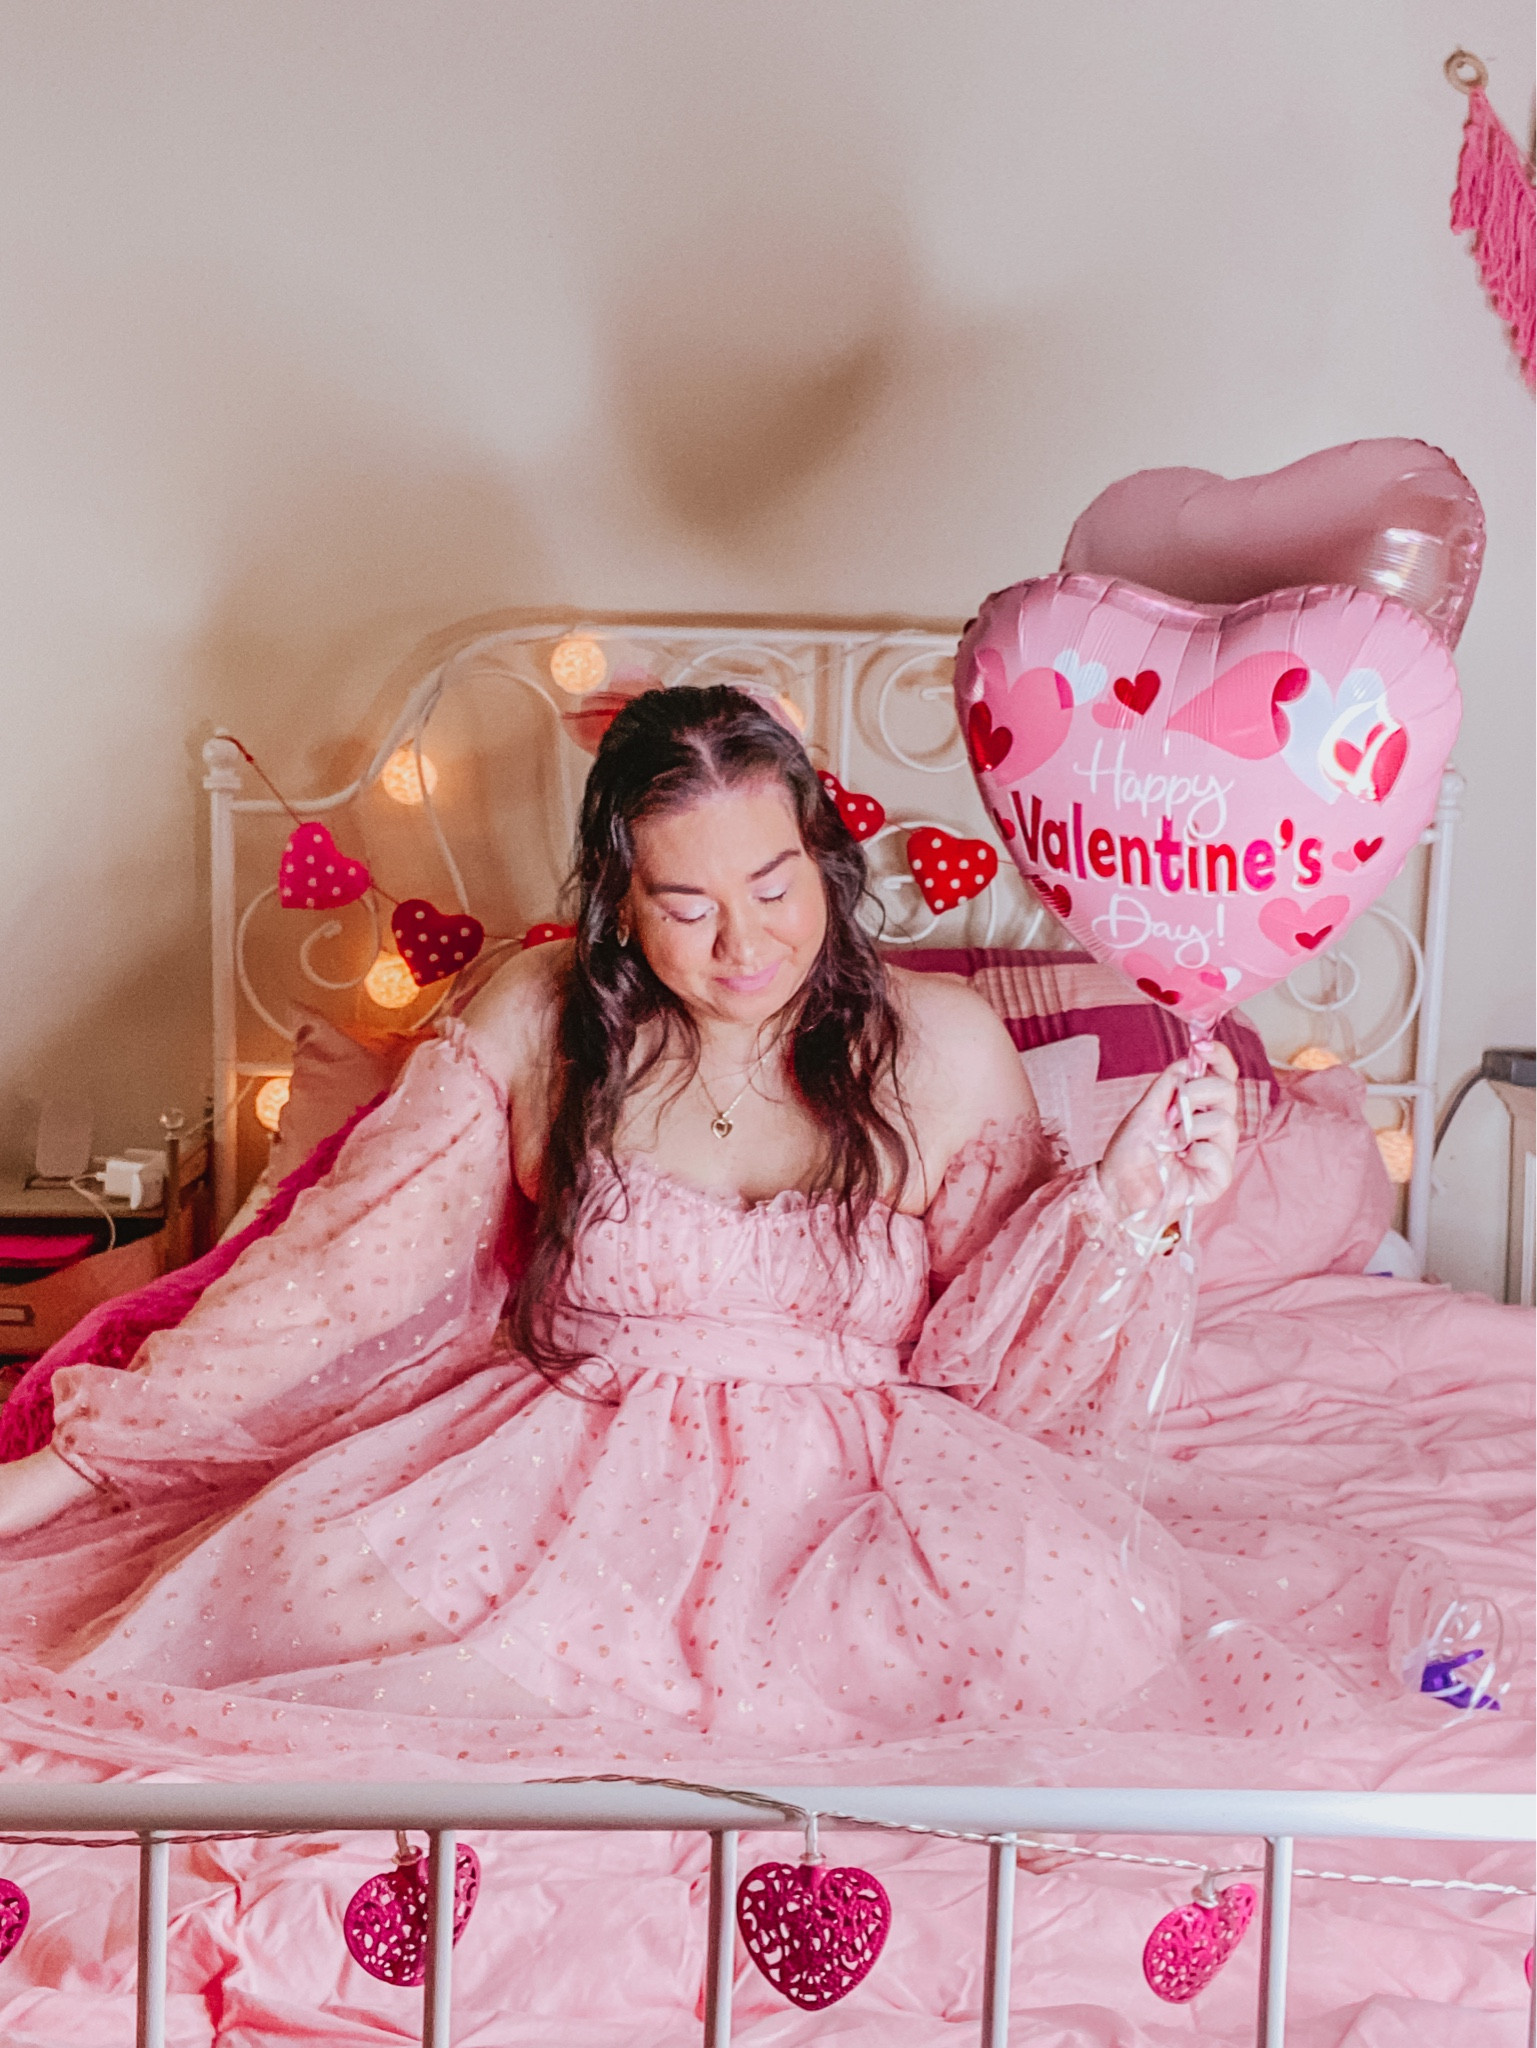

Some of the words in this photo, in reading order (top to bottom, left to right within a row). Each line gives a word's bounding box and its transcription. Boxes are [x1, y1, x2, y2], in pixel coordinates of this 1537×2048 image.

[1073, 738, 1234, 839] Happy
[1009, 790, 1324, 896] Valentine's
[1092, 894, 1226, 969] Day!
